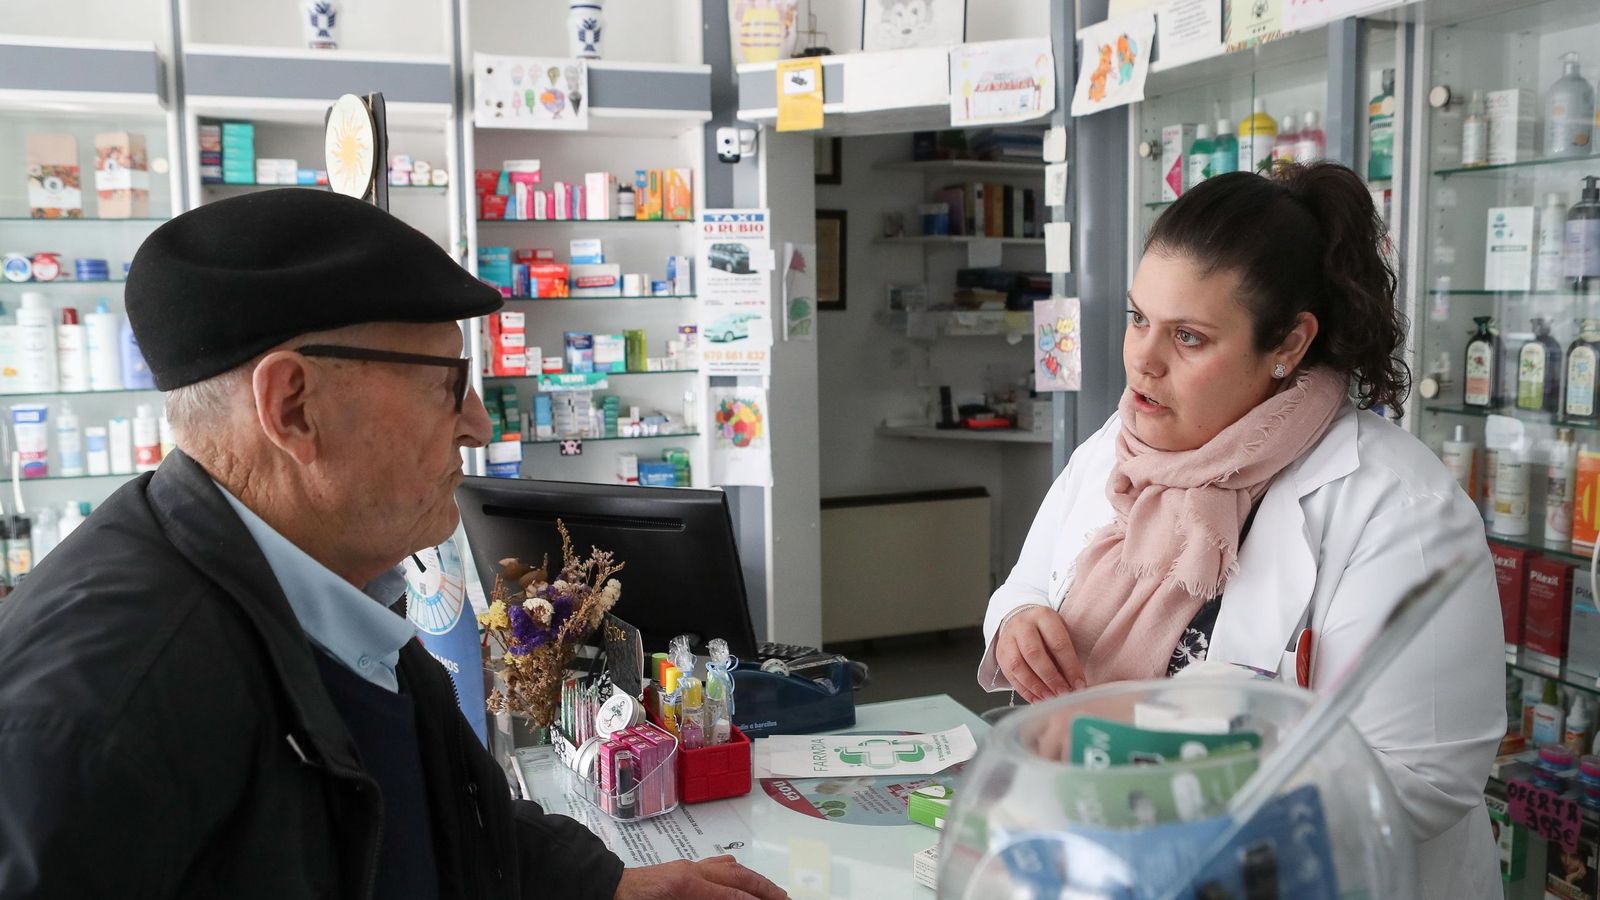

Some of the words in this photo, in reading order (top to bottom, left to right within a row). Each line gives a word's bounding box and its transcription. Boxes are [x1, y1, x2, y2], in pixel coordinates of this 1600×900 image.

[711, 214, 757, 222] TAXI
[704, 224, 713, 232] O
[718, 224, 764, 232] RUBIO
[1494, 553, 1517, 569] lexil
[1530, 570, 1559, 586] Pilexil
